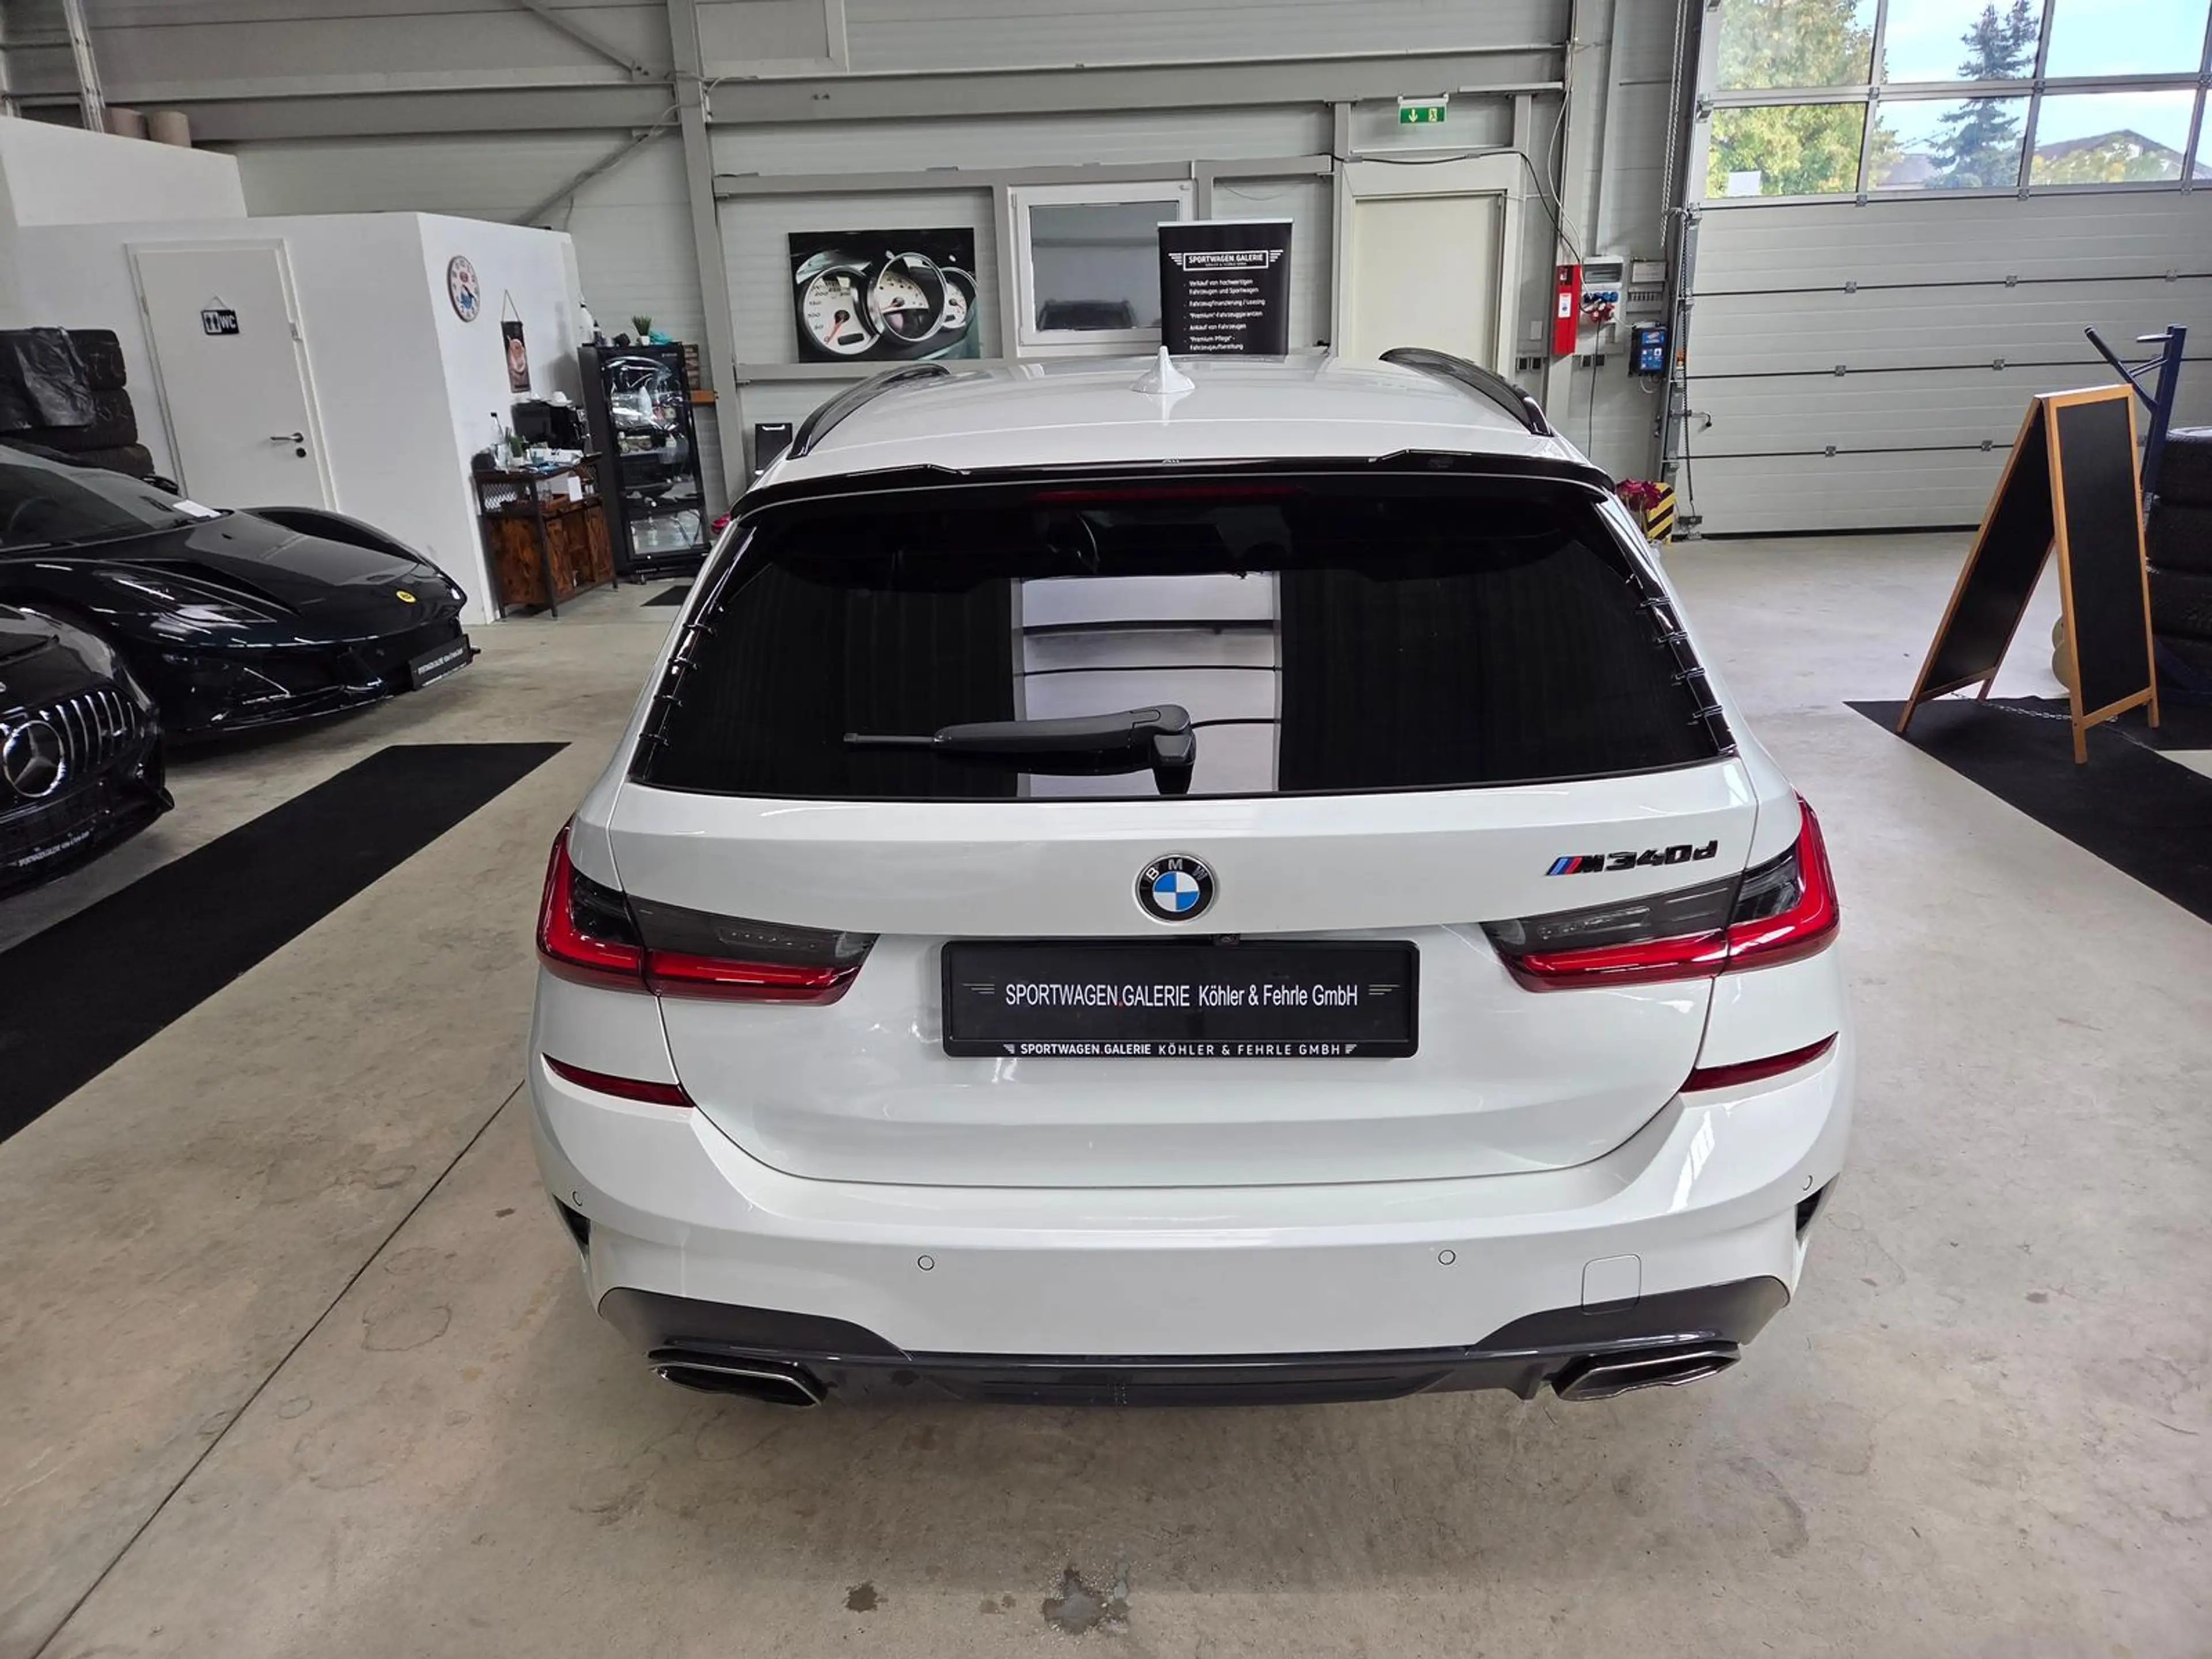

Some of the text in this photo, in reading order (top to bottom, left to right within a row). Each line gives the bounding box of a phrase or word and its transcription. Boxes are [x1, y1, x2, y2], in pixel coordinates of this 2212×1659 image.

[1236, 253, 1263, 262] GALERIE
[219, 315, 236, 329] WC
[1574, 840, 1718, 873] M340d
[1146, 858, 1208, 881] BMW
[1199, 984, 1245, 1006] Köhler
[1248, 984, 1259, 1006] &
[1264, 984, 1308, 1006] Fehrle
[1312, 984, 1357, 1006] GmbH
[1158, 1042, 1214, 1055] KÖHLER
[1222, 1044, 1230, 1055] &
[1238, 1044, 1291, 1055] FEHRLE
[1299, 1044, 1340, 1055] GMBH
